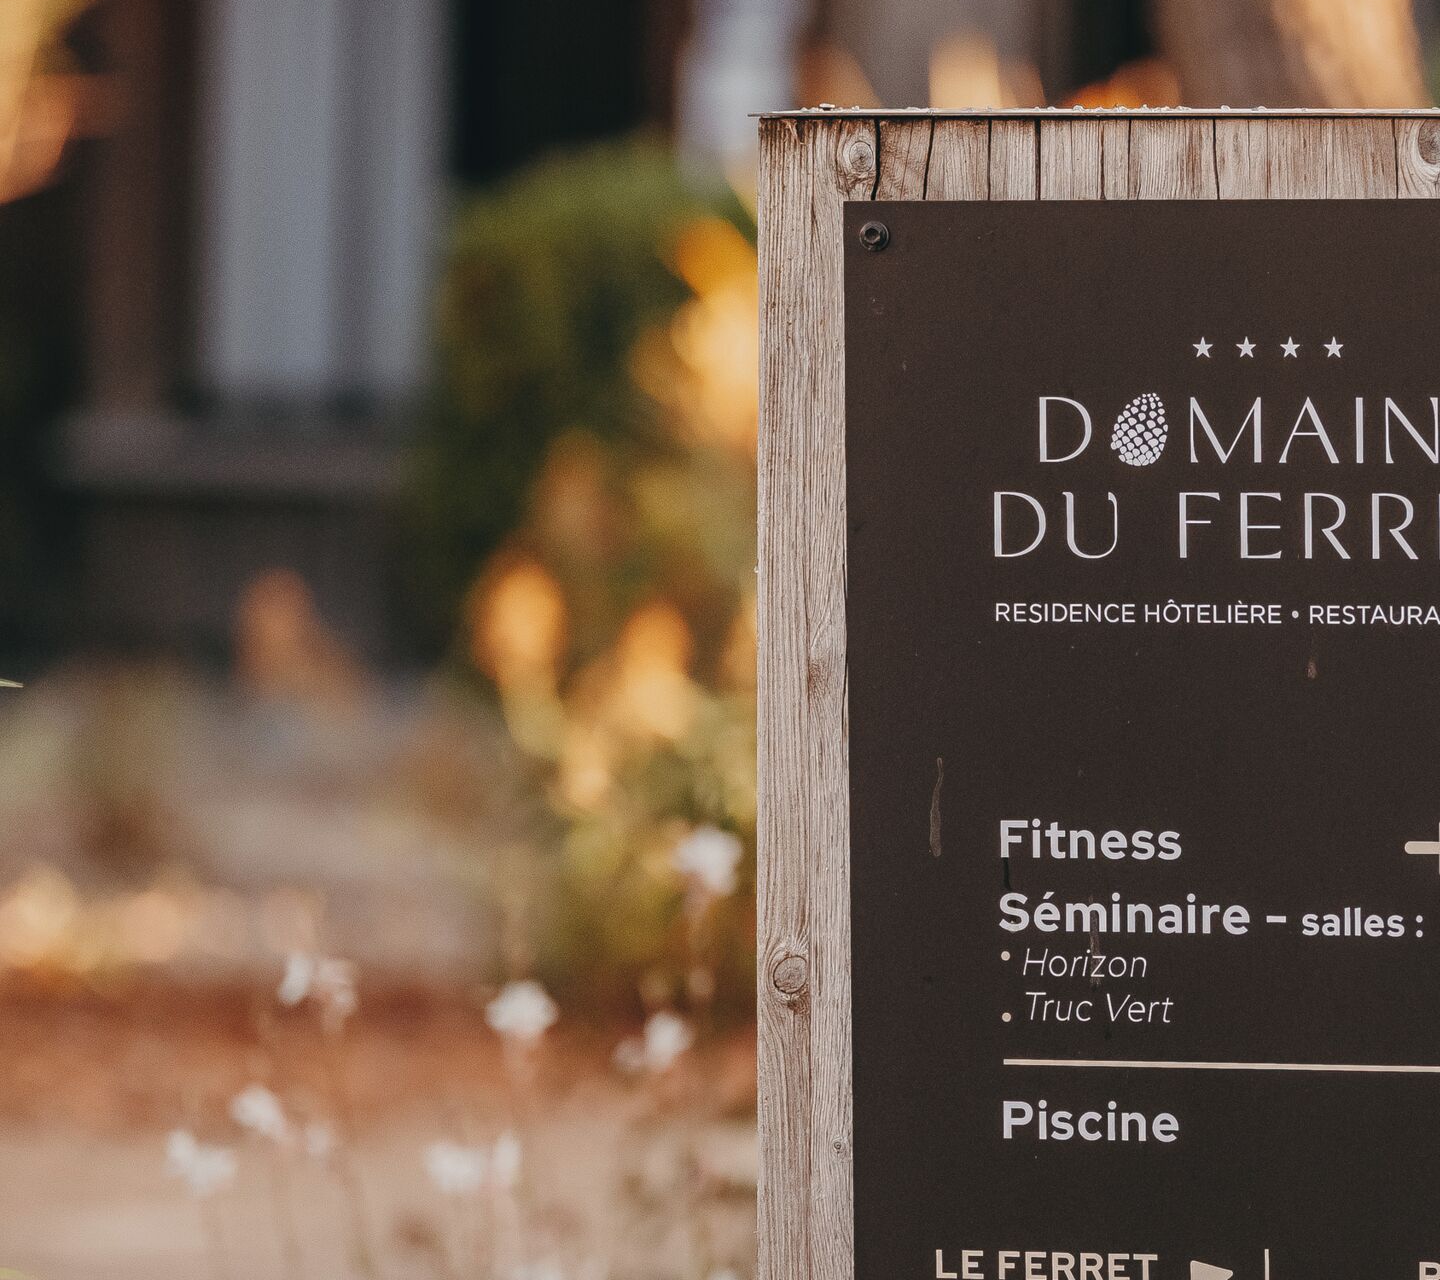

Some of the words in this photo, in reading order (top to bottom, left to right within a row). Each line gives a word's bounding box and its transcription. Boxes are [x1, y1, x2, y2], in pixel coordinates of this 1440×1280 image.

[993, 491, 1118, 559] DU
[995, 602, 1136, 624] RESIDENCE
[1144, 598, 1283, 625] HÔTELIÈRE
[999, 817, 1182, 861] Fitness
[998, 891, 1251, 936] Séminaire
[1301, 906, 1406, 938] salles
[1022, 947, 1147, 978] Horizon
[1025, 991, 1093, 1022] Truc
[1106, 992, 1175, 1024] Vert
[1002, 1099, 1180, 1143] Piscine
[935, 1248, 985, 1280] LE
